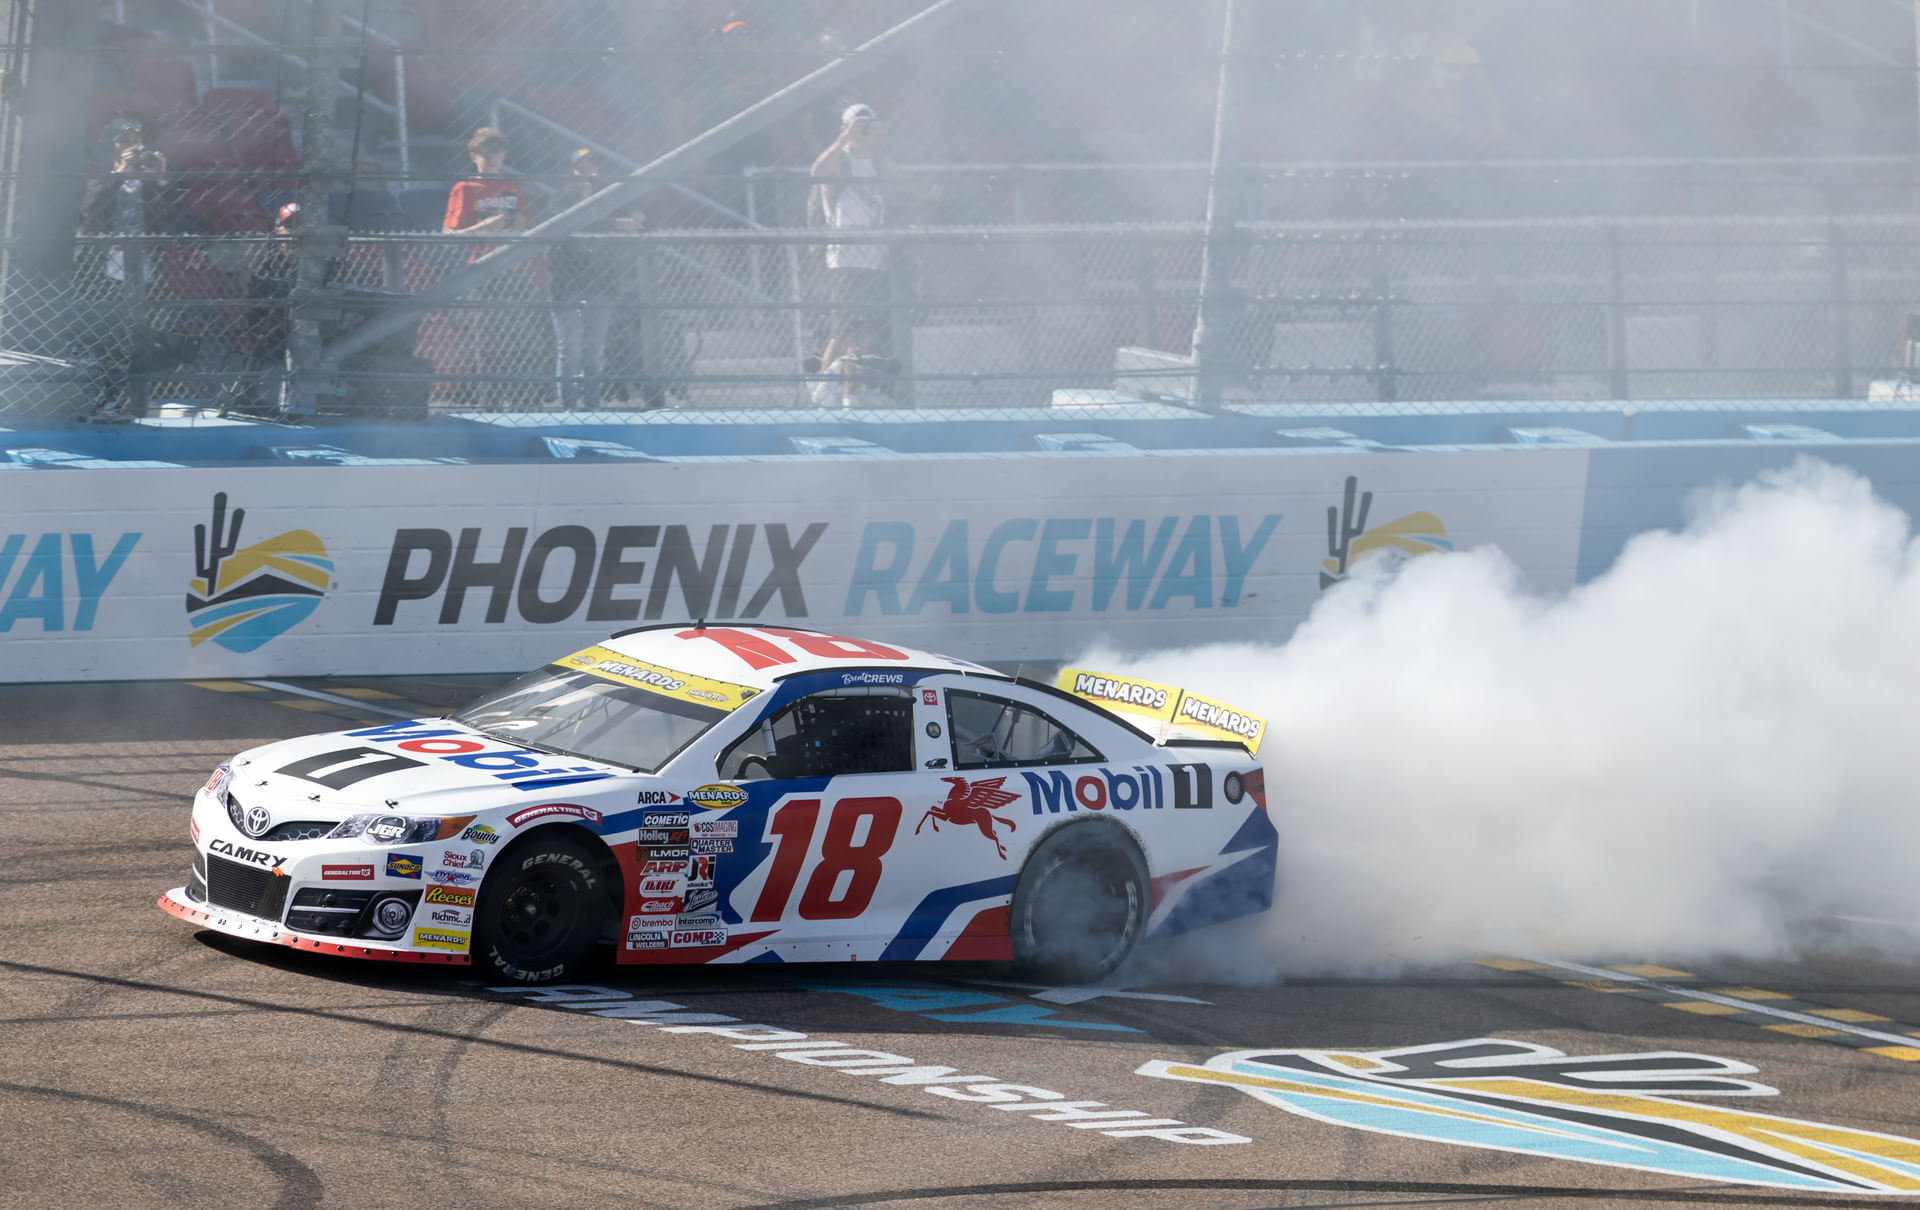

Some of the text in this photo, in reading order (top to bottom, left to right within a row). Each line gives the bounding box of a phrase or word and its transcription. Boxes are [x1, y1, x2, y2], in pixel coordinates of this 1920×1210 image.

[372, 514, 1283, 626] PHOENIX RACEWAY
[674, 627, 910, 671] 18
[592, 659, 686, 692] MENARDS
[864, 674, 904, 685] CREWS
[1073, 673, 1168, 709] MENARDS
[1181, 697, 1262, 740] MENARDS
[343, 720, 617, 791] Mobil
[688, 790, 748, 802] MENARDS
[1020, 765, 1164, 815] Mobil
[638, 791, 666, 804] ARCA
[644, 814, 689, 825] COMETIC
[367, 823, 406, 839] JGR
[461, 828, 500, 845] Bounty
[639, 830, 669, 844] Holley
[692, 839, 731, 850] QUARTER
[698, 845, 732, 854] MASTER
[209, 838, 288, 868] CAMRY
[444, 850, 468, 862] Sioux
[750, 796, 903, 923] 18
[388, 861, 422, 872] SUNOCO
[443, 859, 465, 869] Chief
[643, 861, 689, 873] ARP
[522, 853, 597, 890] GENERAL
[426, 887, 474, 906] Reese's
[432, 911, 471, 925] Richmd
[642, 919, 673, 927] brembo
[678, 916, 716, 926] Intercomp
[419, 932, 466, 944] MENARDS
[629, 932, 662, 941] LINCOLN
[673, 931, 714, 944] COMP
